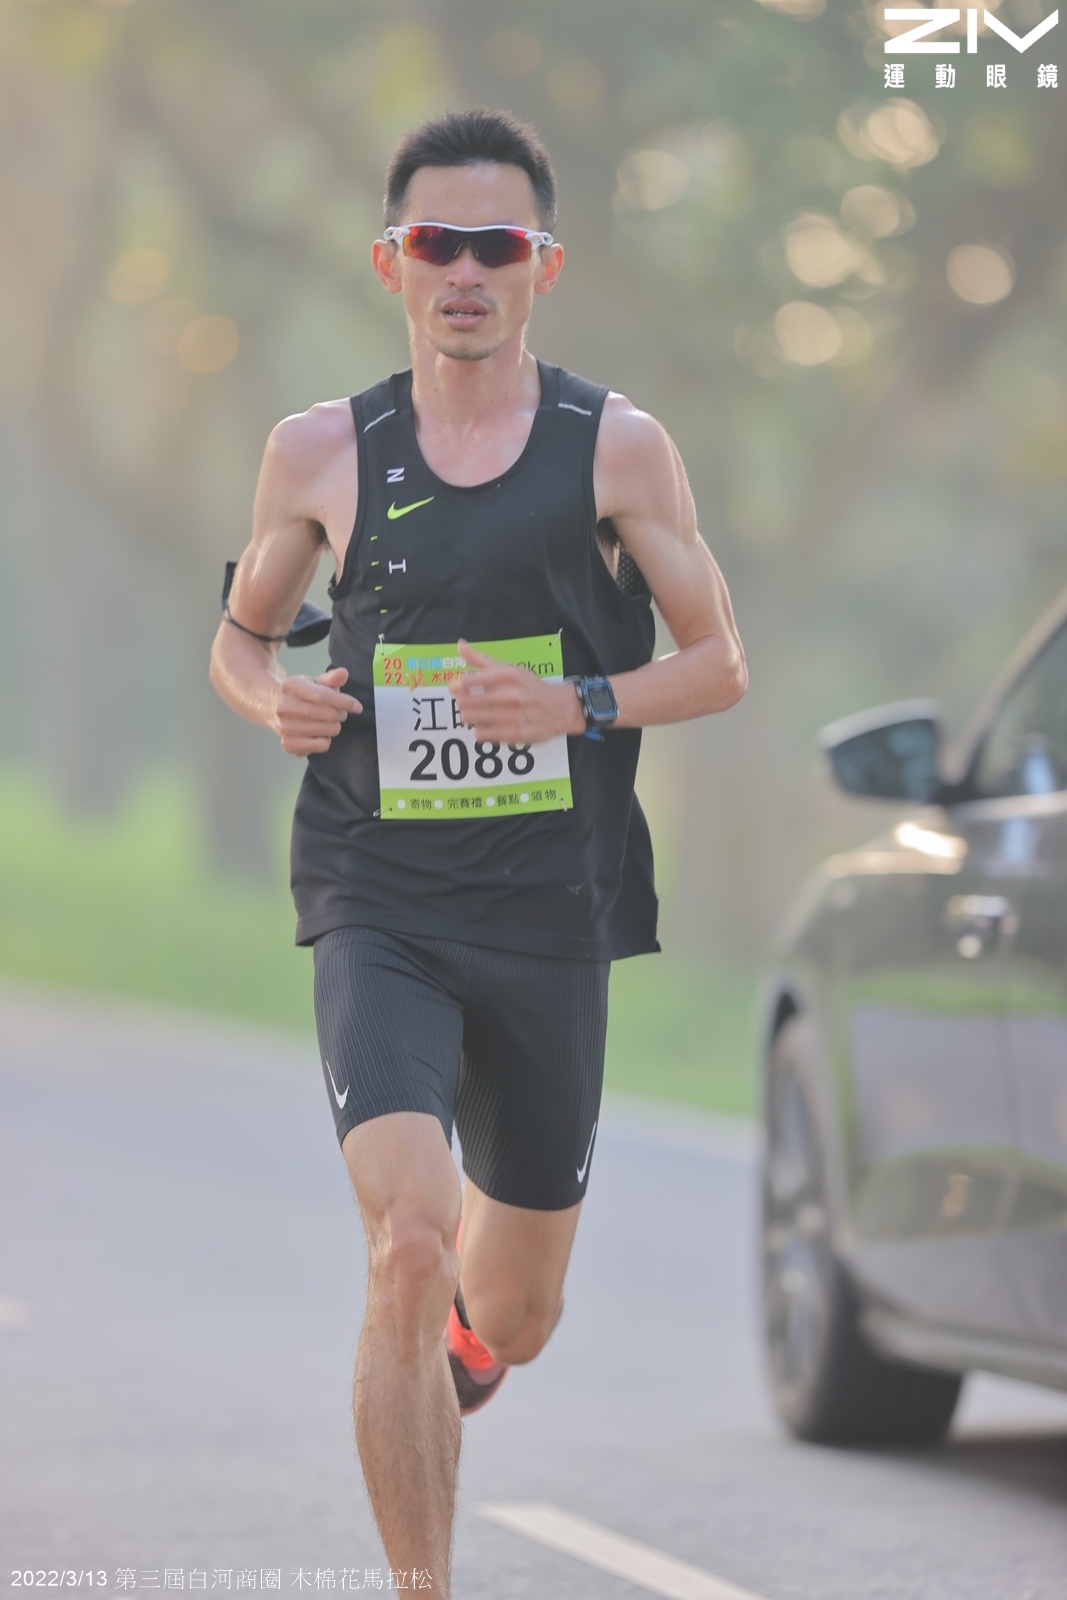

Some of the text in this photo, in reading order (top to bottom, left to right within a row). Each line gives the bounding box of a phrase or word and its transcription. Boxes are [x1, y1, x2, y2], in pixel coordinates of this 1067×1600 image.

[383, 658, 402, 670] 20
[384, 672, 403, 684] 22
[408, 738, 535, 781] 2088
[410, 798, 432, 810] 寄物
[447, 797, 483, 810] 完賽禮
[496, 794, 520, 807] 餐點
